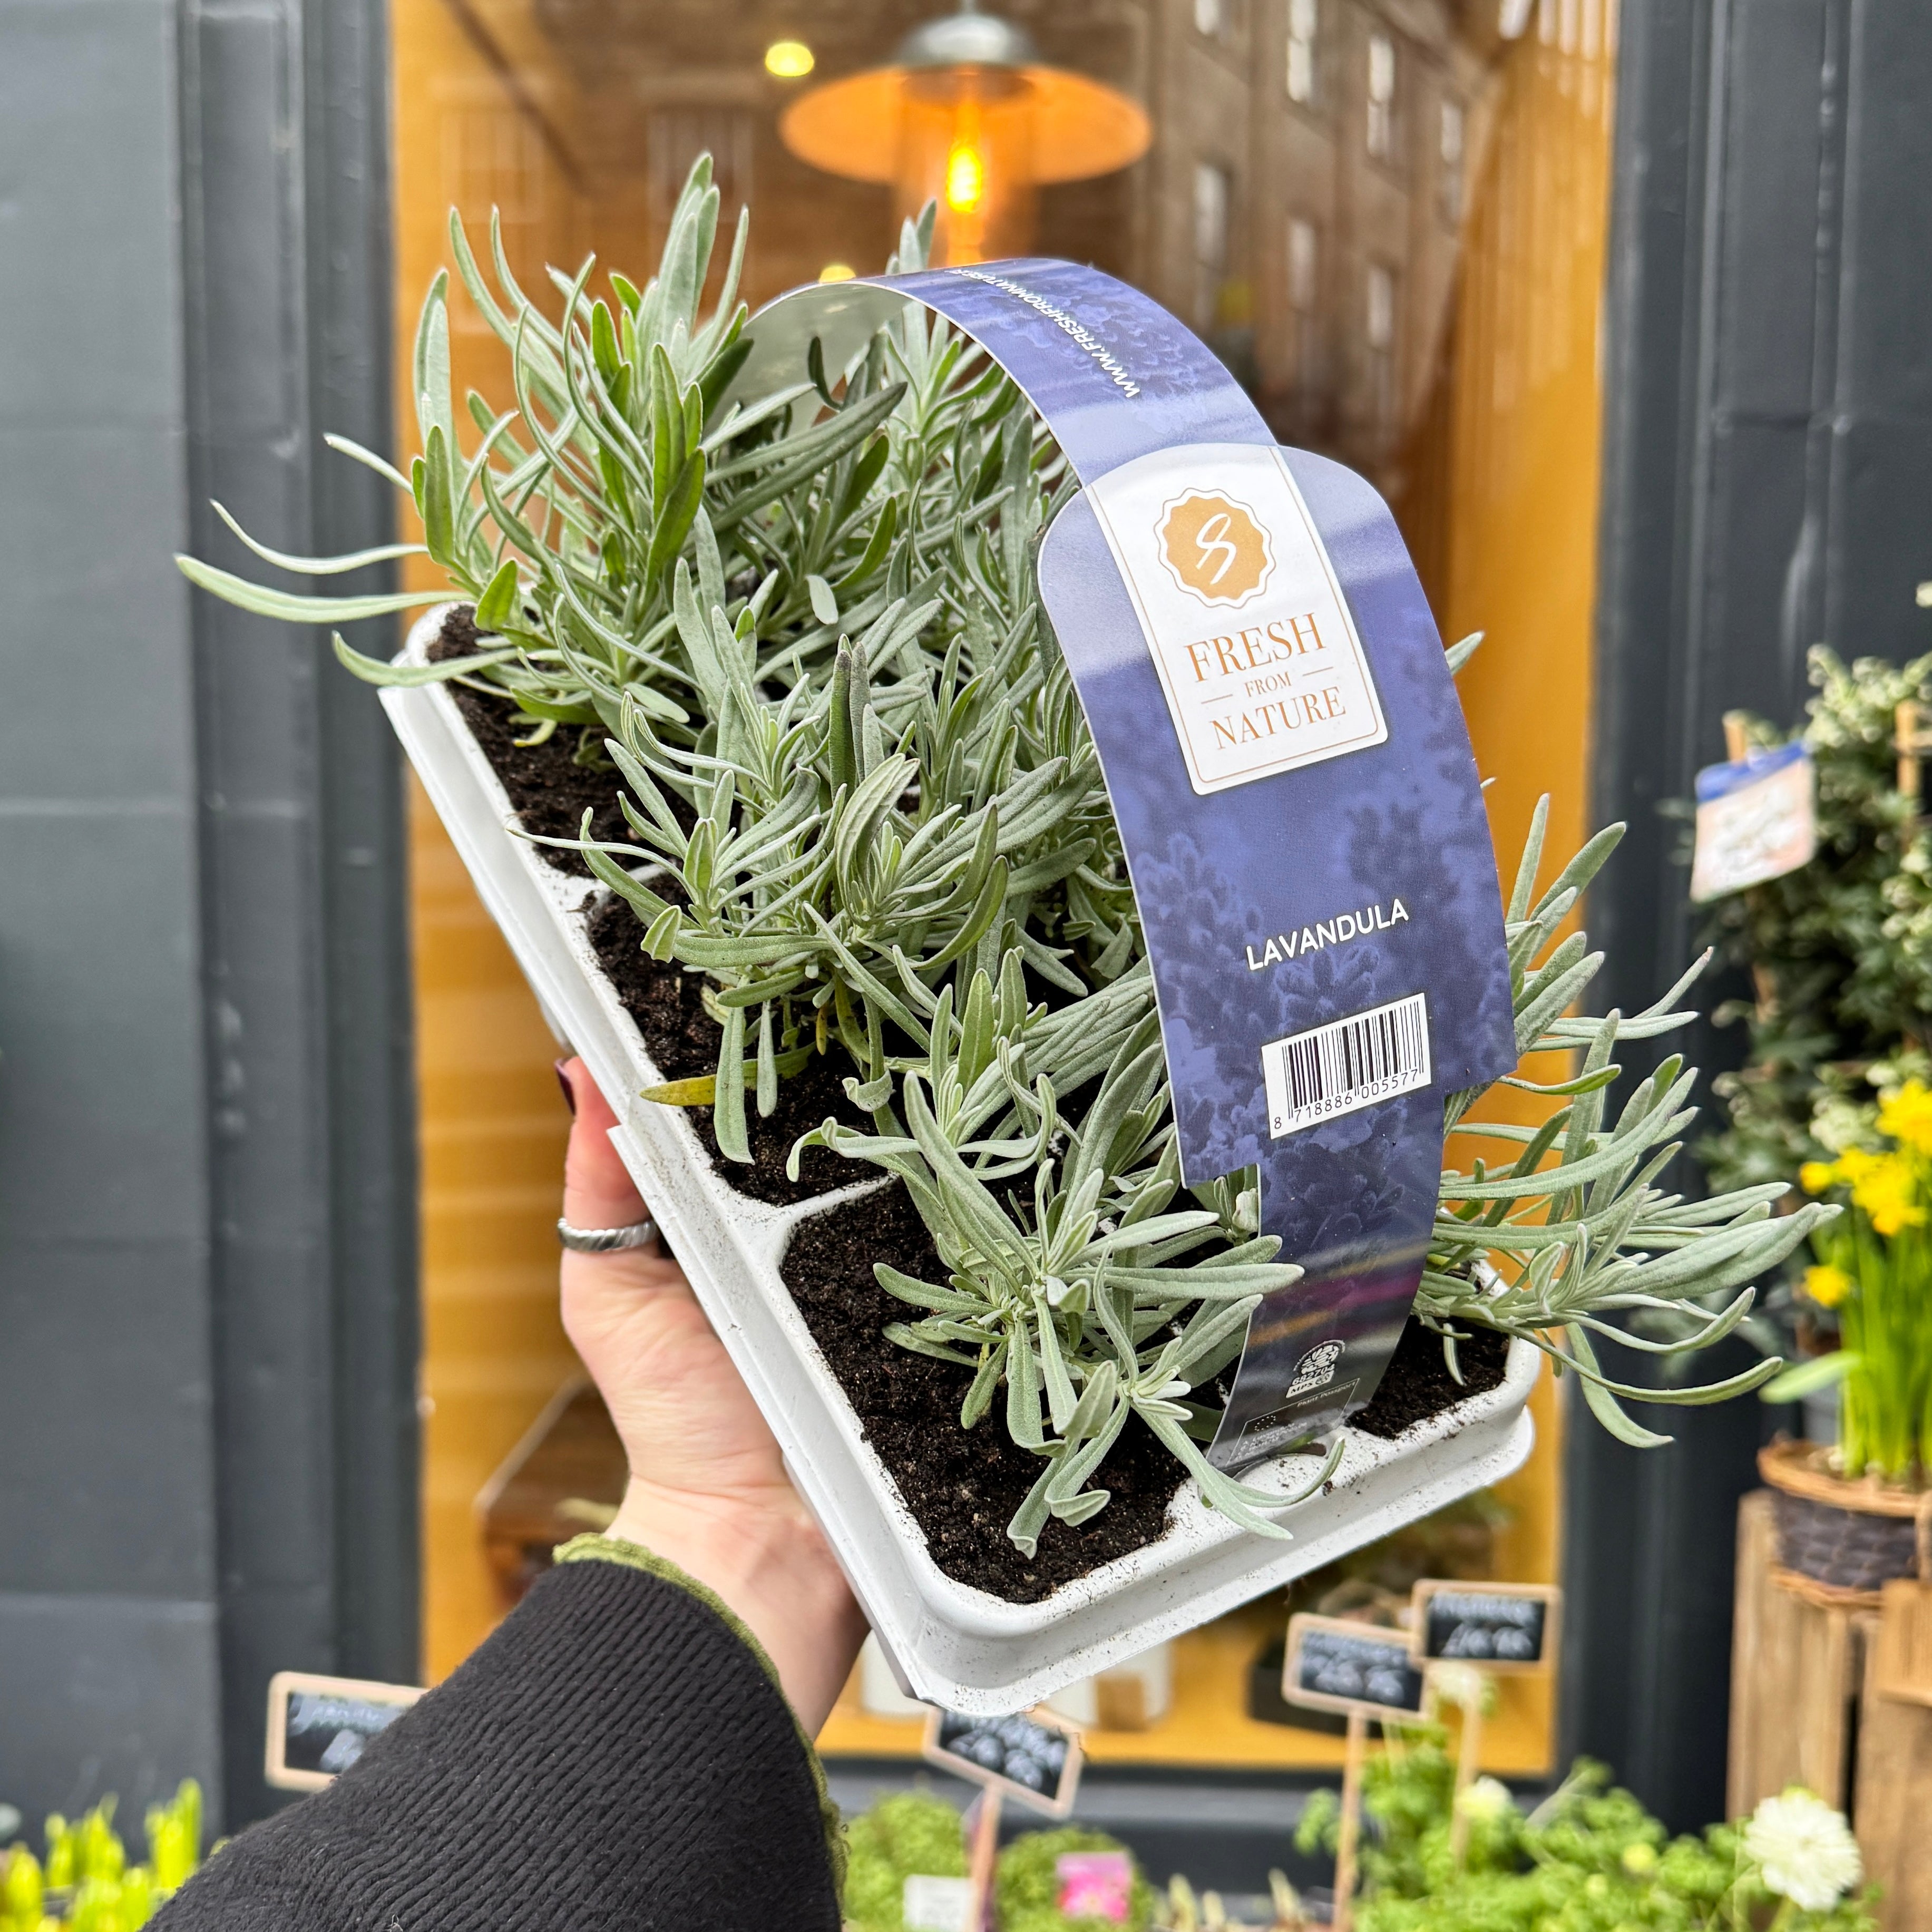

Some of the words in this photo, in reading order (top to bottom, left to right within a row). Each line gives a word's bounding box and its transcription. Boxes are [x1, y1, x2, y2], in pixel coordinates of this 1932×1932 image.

[1183, 612, 1327, 683] FRESH
[1244, 671, 1292, 698] FROM
[1209, 686, 1347, 750] NATURE
[1246, 898, 1409, 971] LAVANDULA
[1273, 1117, 1282, 1129] 8
[1294, 1091, 1353, 1123] 718886
[1361, 1069, 1419, 1099] 005577
